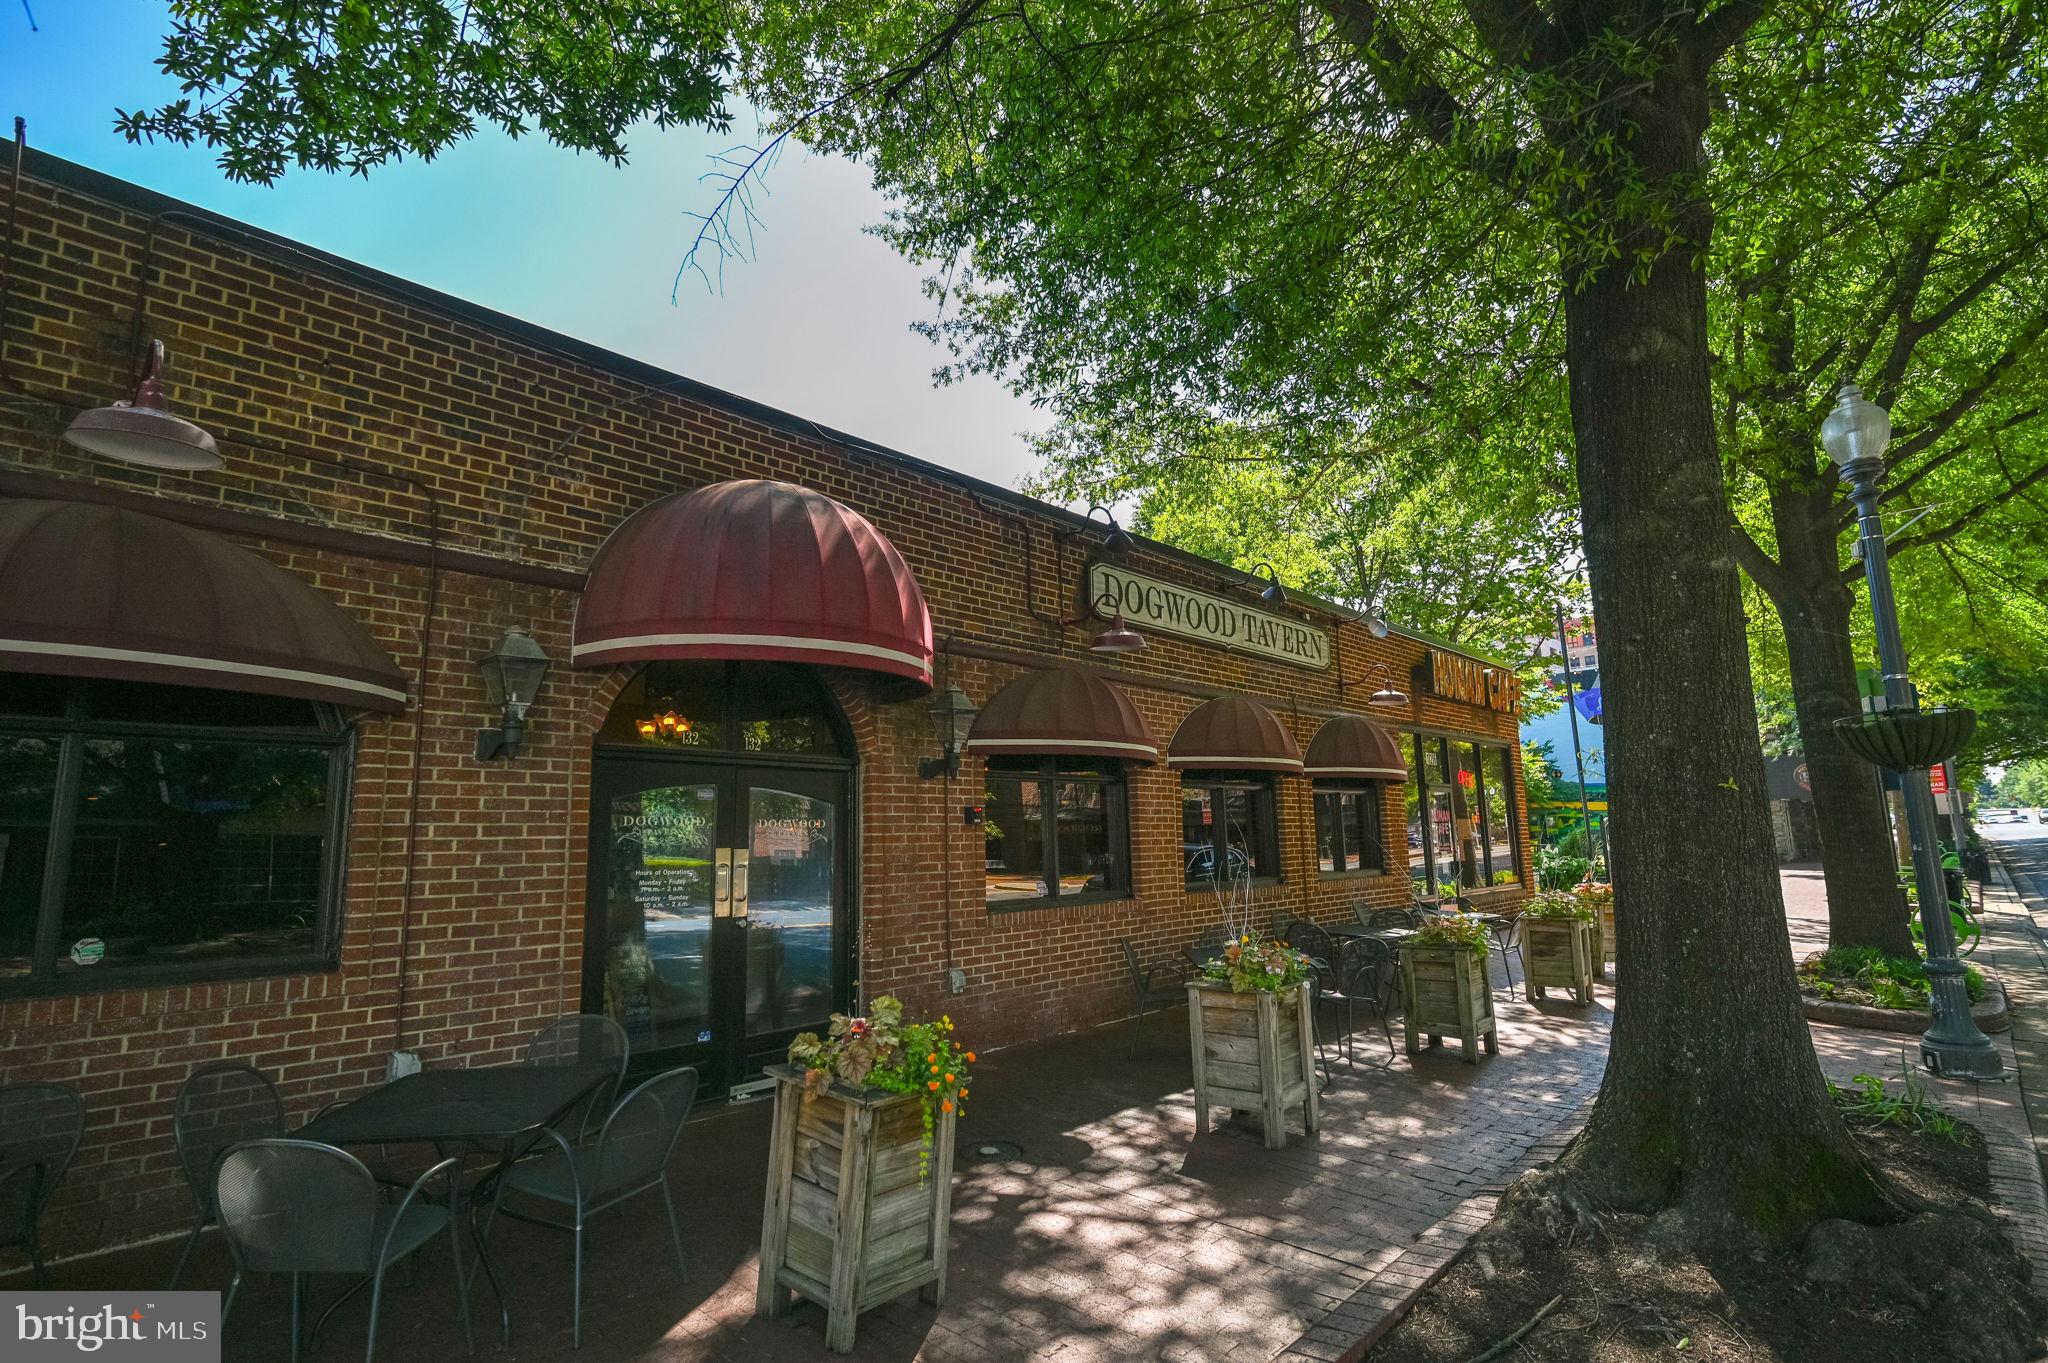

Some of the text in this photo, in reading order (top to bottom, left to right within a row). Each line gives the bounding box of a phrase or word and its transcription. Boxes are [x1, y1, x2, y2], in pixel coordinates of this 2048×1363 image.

[1101, 572, 1323, 662] DOGWOOD TAVERN
[682, 731, 699, 745] 132
[745, 737, 761, 751] 132
[623, 815, 706, 827] DOGWOOD
[758, 818, 826, 829] DOGWOOD
